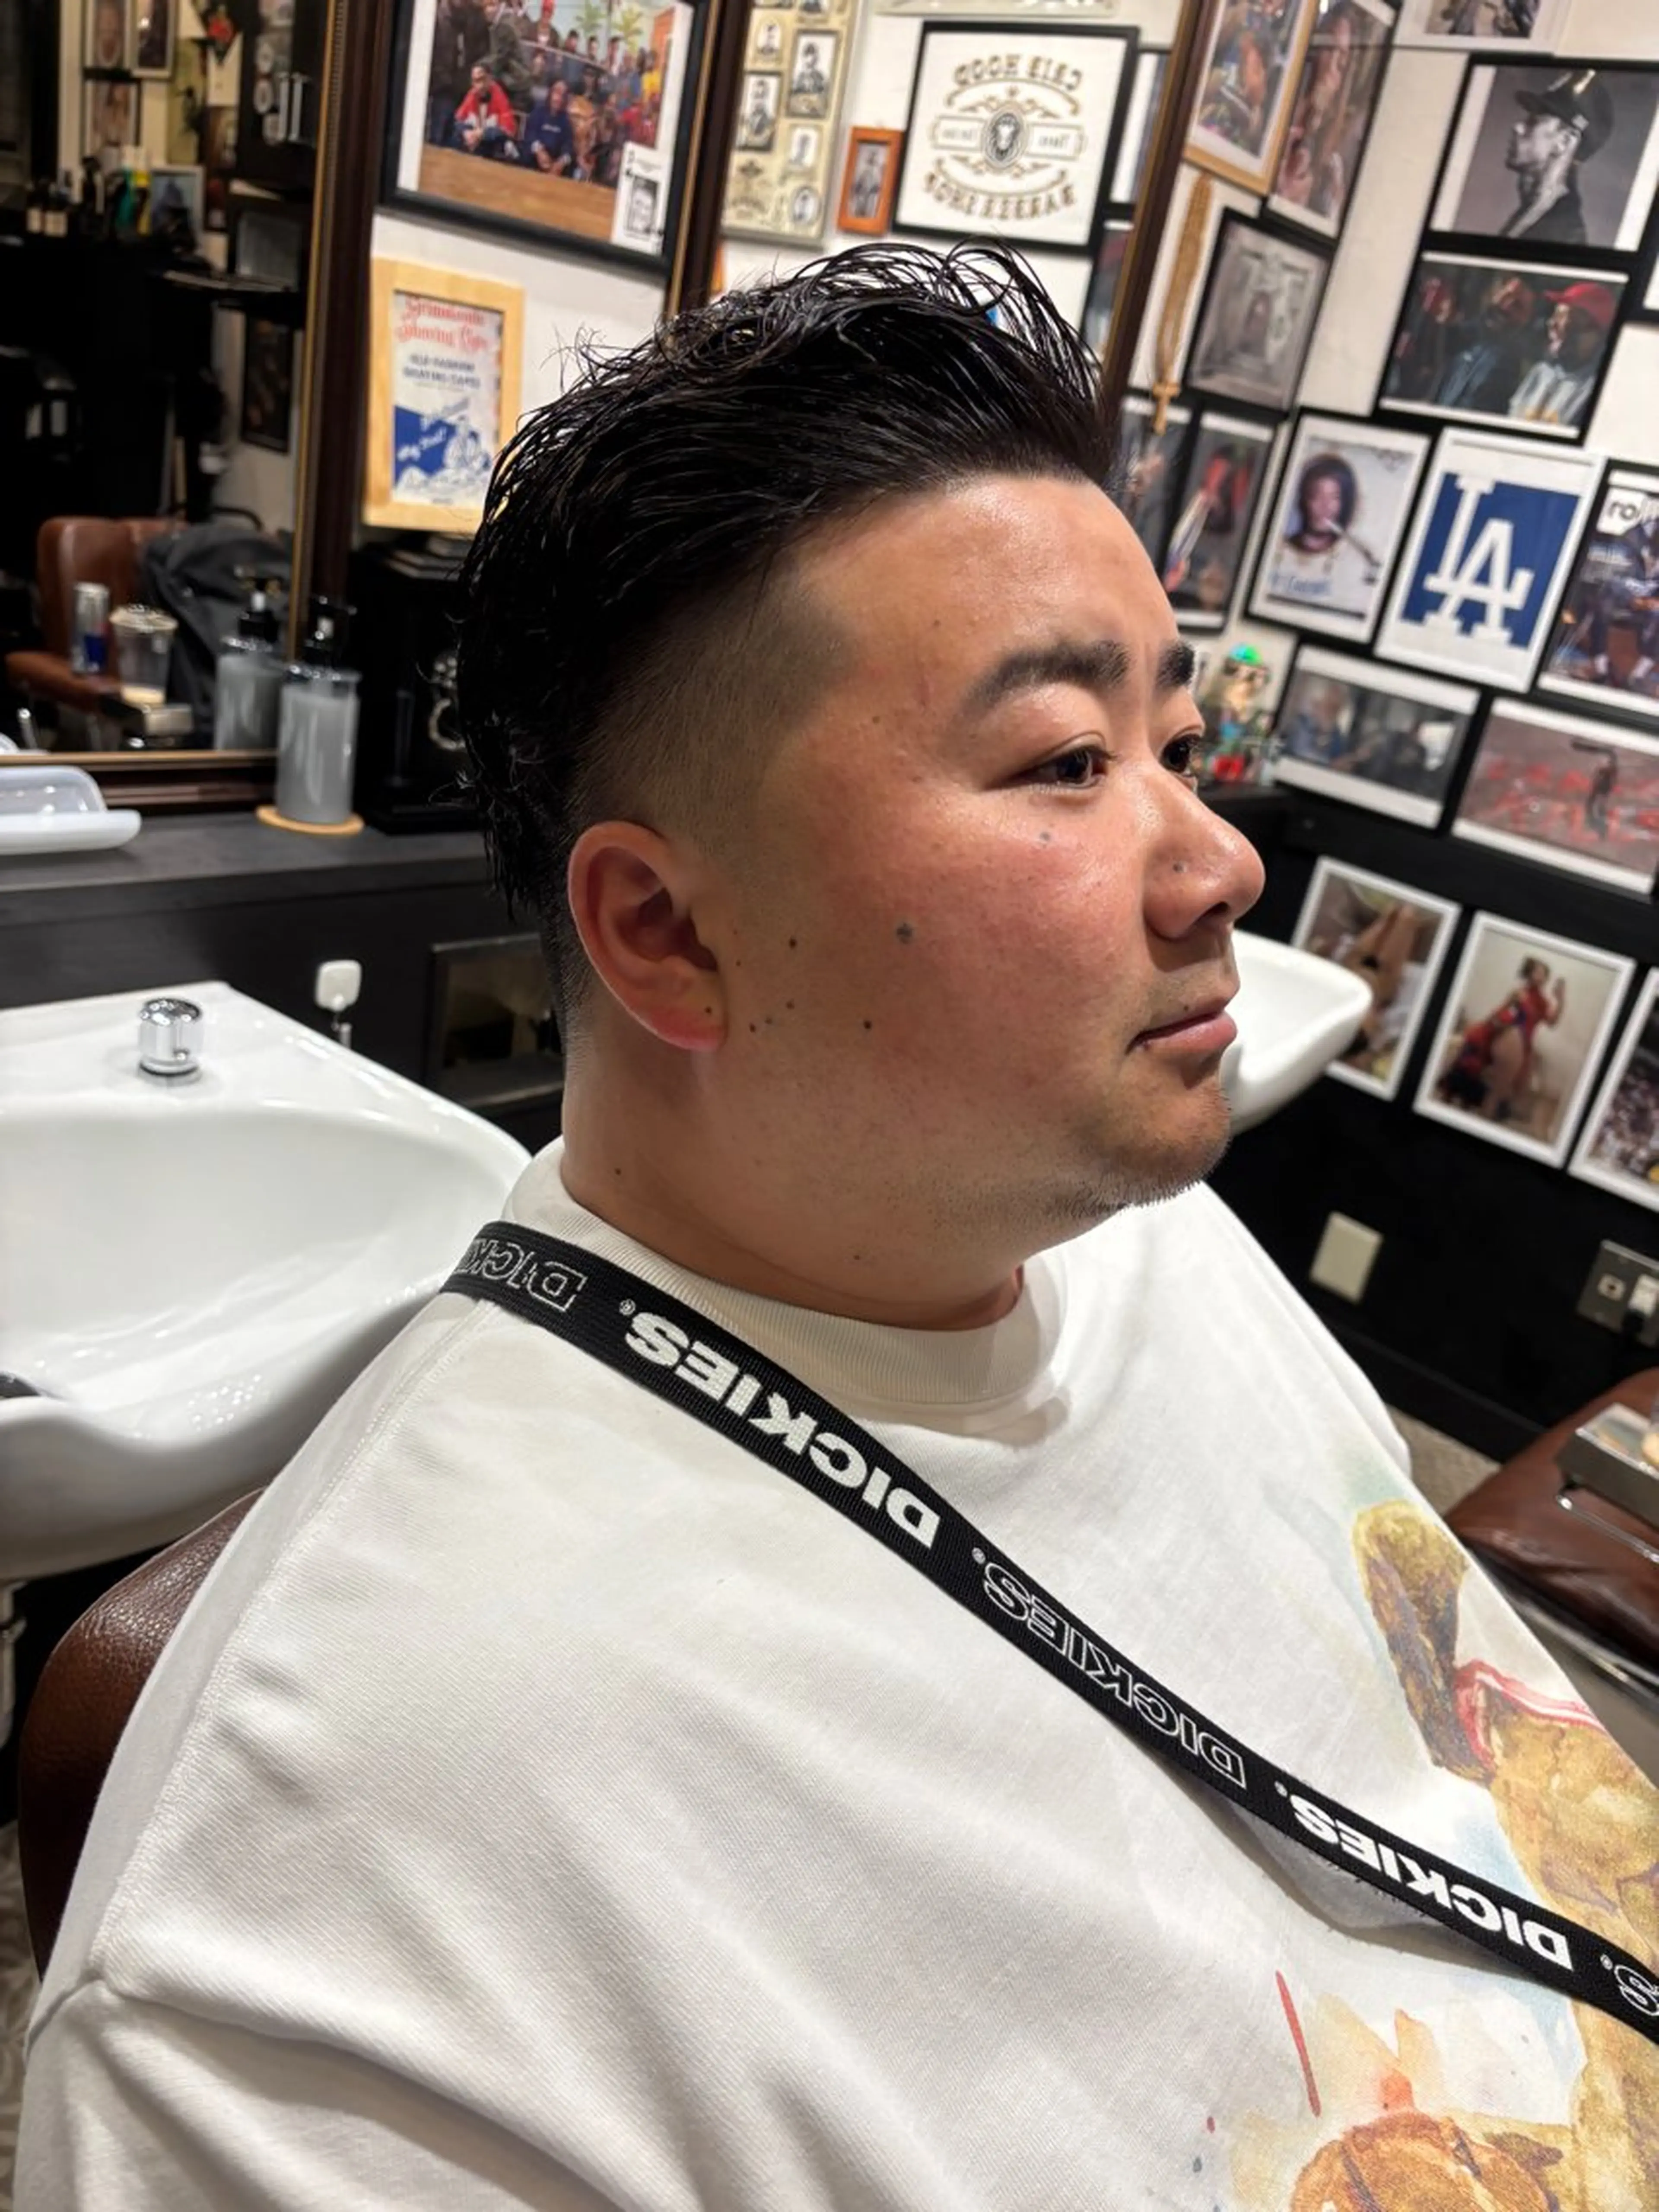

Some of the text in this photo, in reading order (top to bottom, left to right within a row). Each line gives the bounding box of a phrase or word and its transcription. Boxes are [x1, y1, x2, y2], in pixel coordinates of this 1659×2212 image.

[1423, 474, 1535, 644] LA
[625, 1312, 941, 1549] DICKIES
[983, 1562, 1247, 1789] DICKIES
[1290, 1794, 1573, 1971] DICKIES
